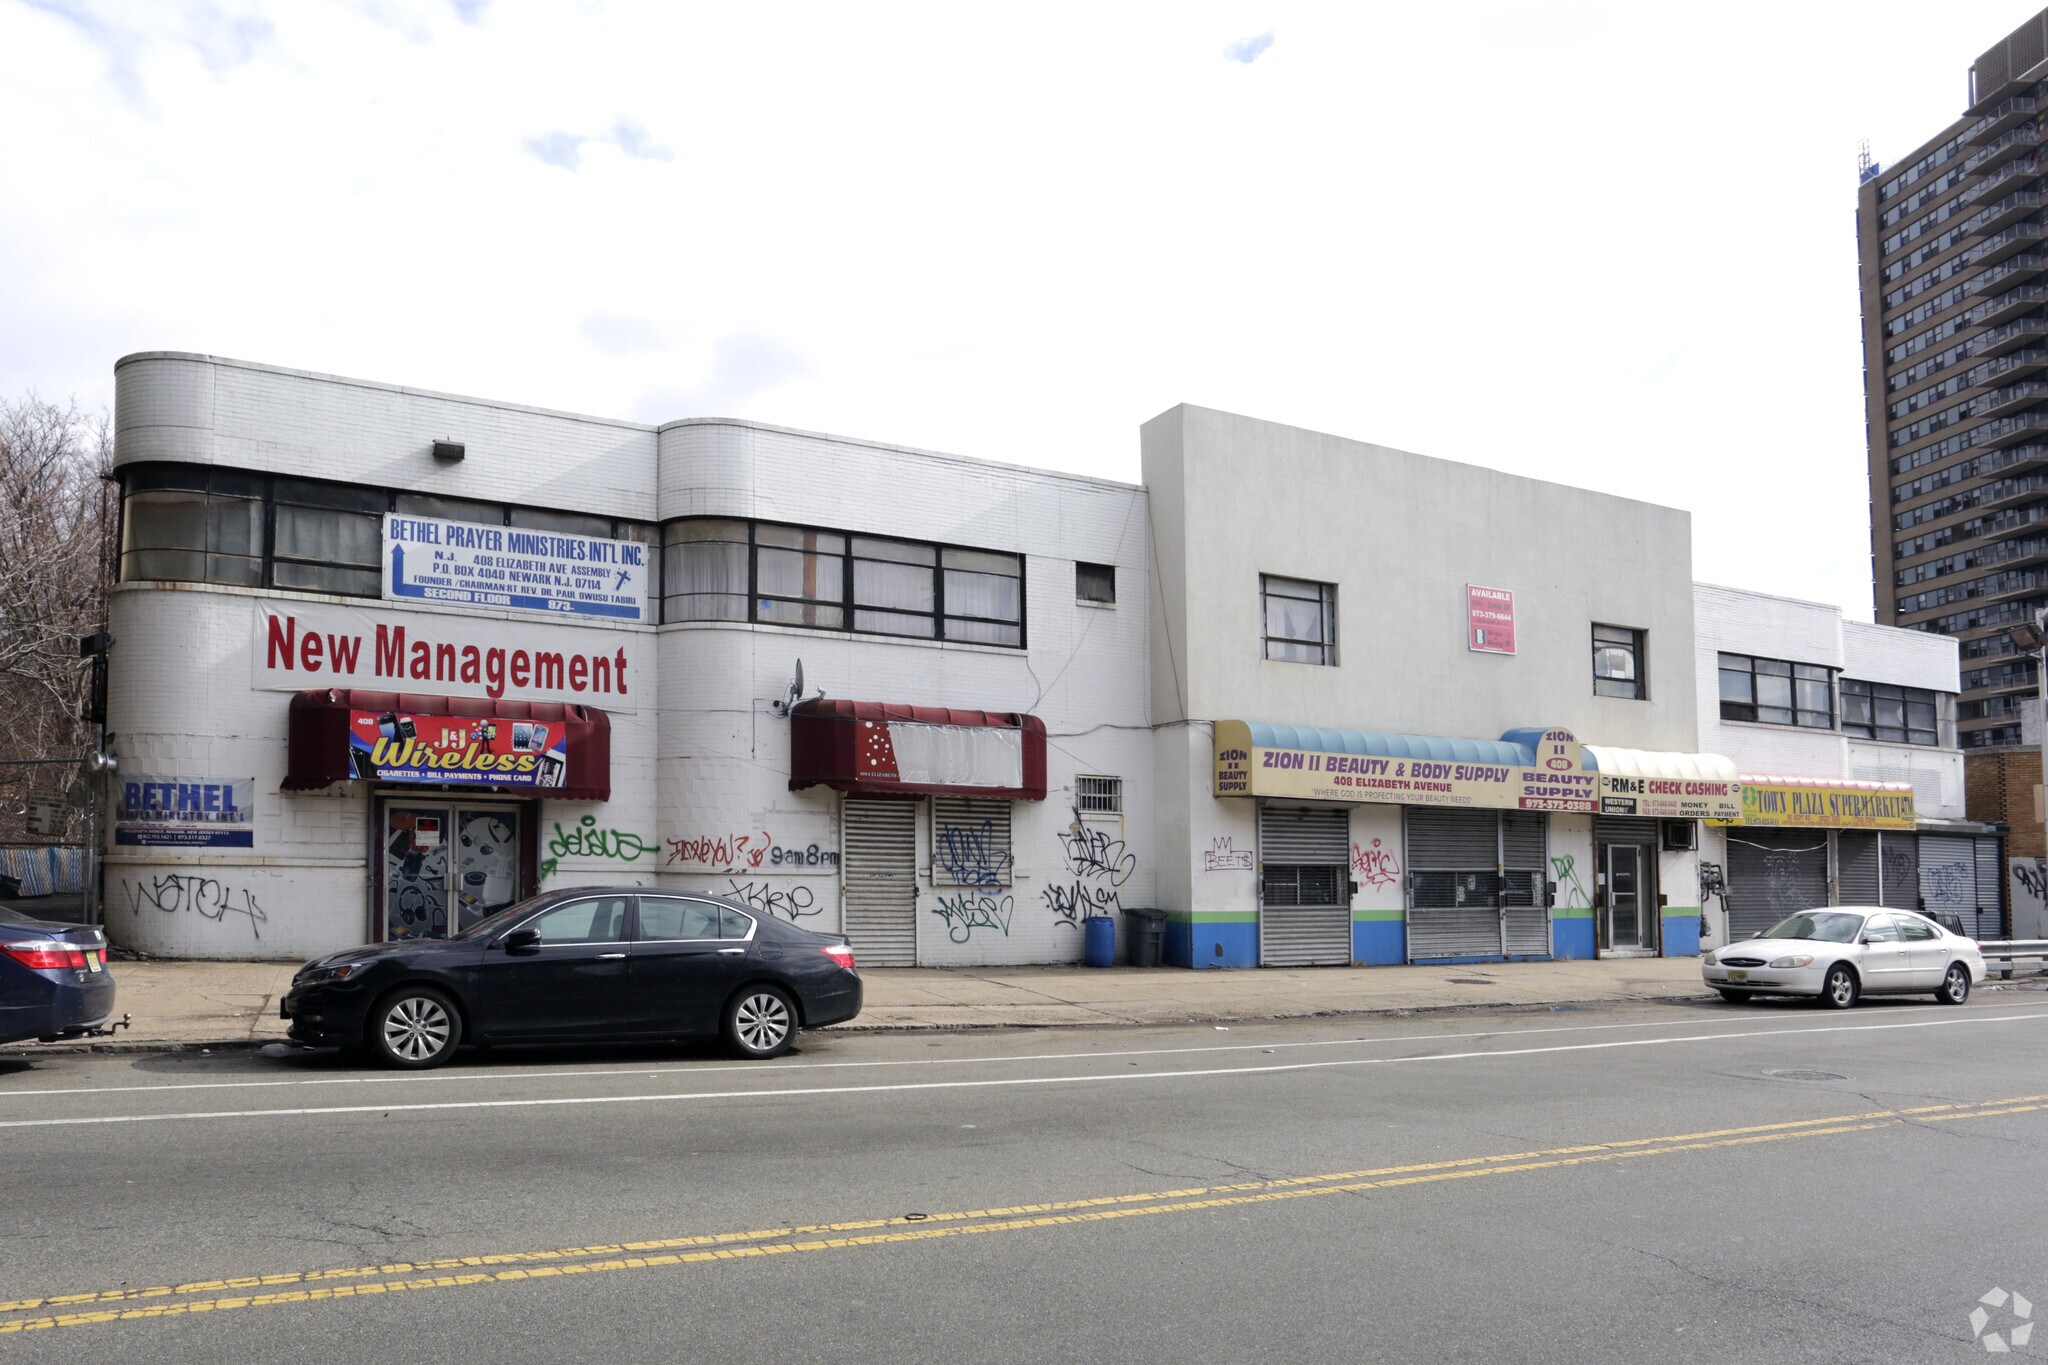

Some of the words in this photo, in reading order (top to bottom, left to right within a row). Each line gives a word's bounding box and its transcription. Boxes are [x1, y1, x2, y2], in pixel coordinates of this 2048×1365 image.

[389, 518, 441, 545] BETHEL
[446, 525, 502, 552] PRAYER
[508, 532, 586, 561] MINISTRIES
[589, 541, 618, 564] INT'L
[621, 544, 645, 566] INC.
[434, 551, 457, 561] N.J.
[473, 555, 493, 567] 408
[496, 557, 546, 572] ELIZABETH
[549, 563, 567, 575] AVE
[571, 565, 611, 578] ASSEMBLY
[433, 563, 451, 574] P.O.
[454, 565, 474, 577] BOX
[478, 568, 505, 580] 4040
[509, 571, 551, 585] NEWARK
[554, 575, 572, 587] N.J.
[575, 578, 602, 590] 07114
[414, 575, 452, 587] FOUNDER
[541, 589, 554, 597] DR.
[556, 589, 576, 599] PAUL
[579, 592, 608, 602] OWUSU
[610, 595, 636, 605] TABIRI
[424, 588, 471, 602] SECOND
[474, 592, 511, 605] FLOOR
[1471, 588, 1511, 601] AVAILABLE
[267, 615, 362, 675] New
[375, 624, 628, 699] Management
[434, 727, 470, 749] J&J
[1546, 731, 1574, 742] ZION
[371, 737, 546, 772] Wireless
[1219, 749, 1247, 761] ZION
[1554, 745, 1565, 754] II
[1263, 751, 1304, 769] ZION
[1308, 755, 1321, 771] II
[1325, 756, 1389, 775] BEAUTY
[1395, 762, 1405, 777] &
[1411, 763, 1452, 779] BODY
[1454, 765, 1510, 783] SUPPLY
[1551, 760, 1568, 769] 408
[376, 769, 420, 778] CIGARETTES
[427, 771, 442, 779] BILL
[444, 772, 482, 780] PAYMENTS
[489, 774, 510, 782] PHONE
[513, 774, 532, 782] CARD
[1219, 771, 1248, 780] BEAUTY
[1523, 772, 1594, 785] BEAUTY
[1219, 782, 1247, 791] SUPPLY
[1334, 776, 1352, 787] 408
[1356, 777, 1410, 790] ELIZABETH
[1413, 781, 1452, 793] AVENUE
[1649, 780, 1682, 795] CHECK
[1685, 782, 1728, 797] CASHING
[125, 782, 238, 812] BETHEL
[1341, 790, 1354, 798] GOD
[1407, 793, 1424, 801] YOUR
[1426, 795, 1448, 803] BEAUTY
[1524, 786, 1593, 798] SUPPLY
[1525, 799, 1592, 811] 973-373-0388
[1604, 798, 1634, 806] WESTERN
[1757, 790, 1786, 814] TOWN
[1792, 791, 1824, 815] PLAZA
[1829, 793, 1901, 818] SUPERMARKET
[156, 811, 210, 820] MINISTRY
[216, 812, 245, 822] INT'L
